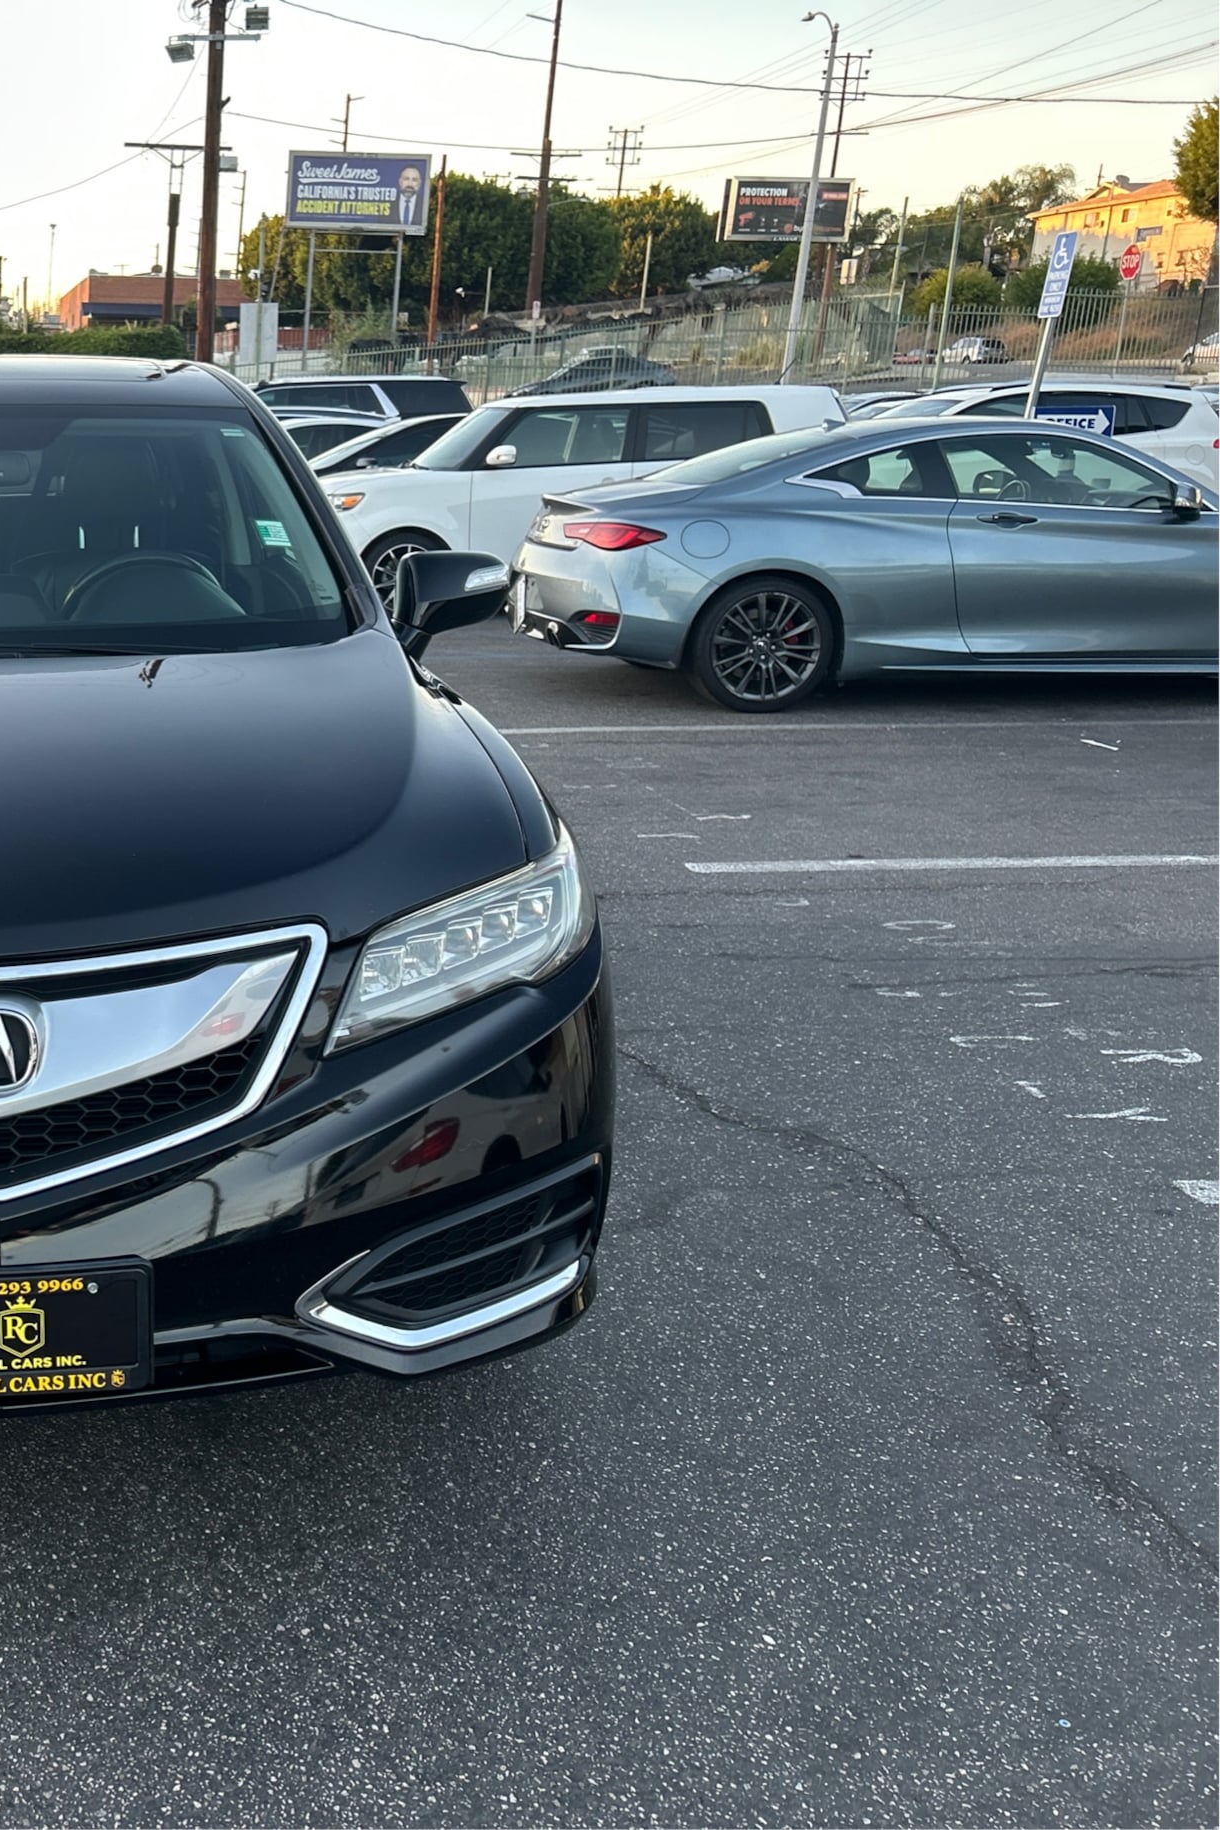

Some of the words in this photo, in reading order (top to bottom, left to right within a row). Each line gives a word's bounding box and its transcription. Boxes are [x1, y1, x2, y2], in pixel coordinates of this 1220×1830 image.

[297, 184, 356, 200] CALIFORNIA'S
[357, 186, 397, 202] TRUSTED
[740, 187, 788, 197] PROTECTION
[296, 199, 340, 214] ACCIDENT
[340, 201, 391, 217] ATTORNEYS
[751, 197, 773, 206] YOUR
[1122, 254, 1140, 270] STOP
[37, 1278, 84, 1293] 9966
[3, 1315, 39, 1345] RC
[11, 1356, 53, 1370] CARS
[56, 1354, 87, 1367] INC.
[9, 1376, 65, 1392] CARS
[67, 1373, 106, 1390] INC
